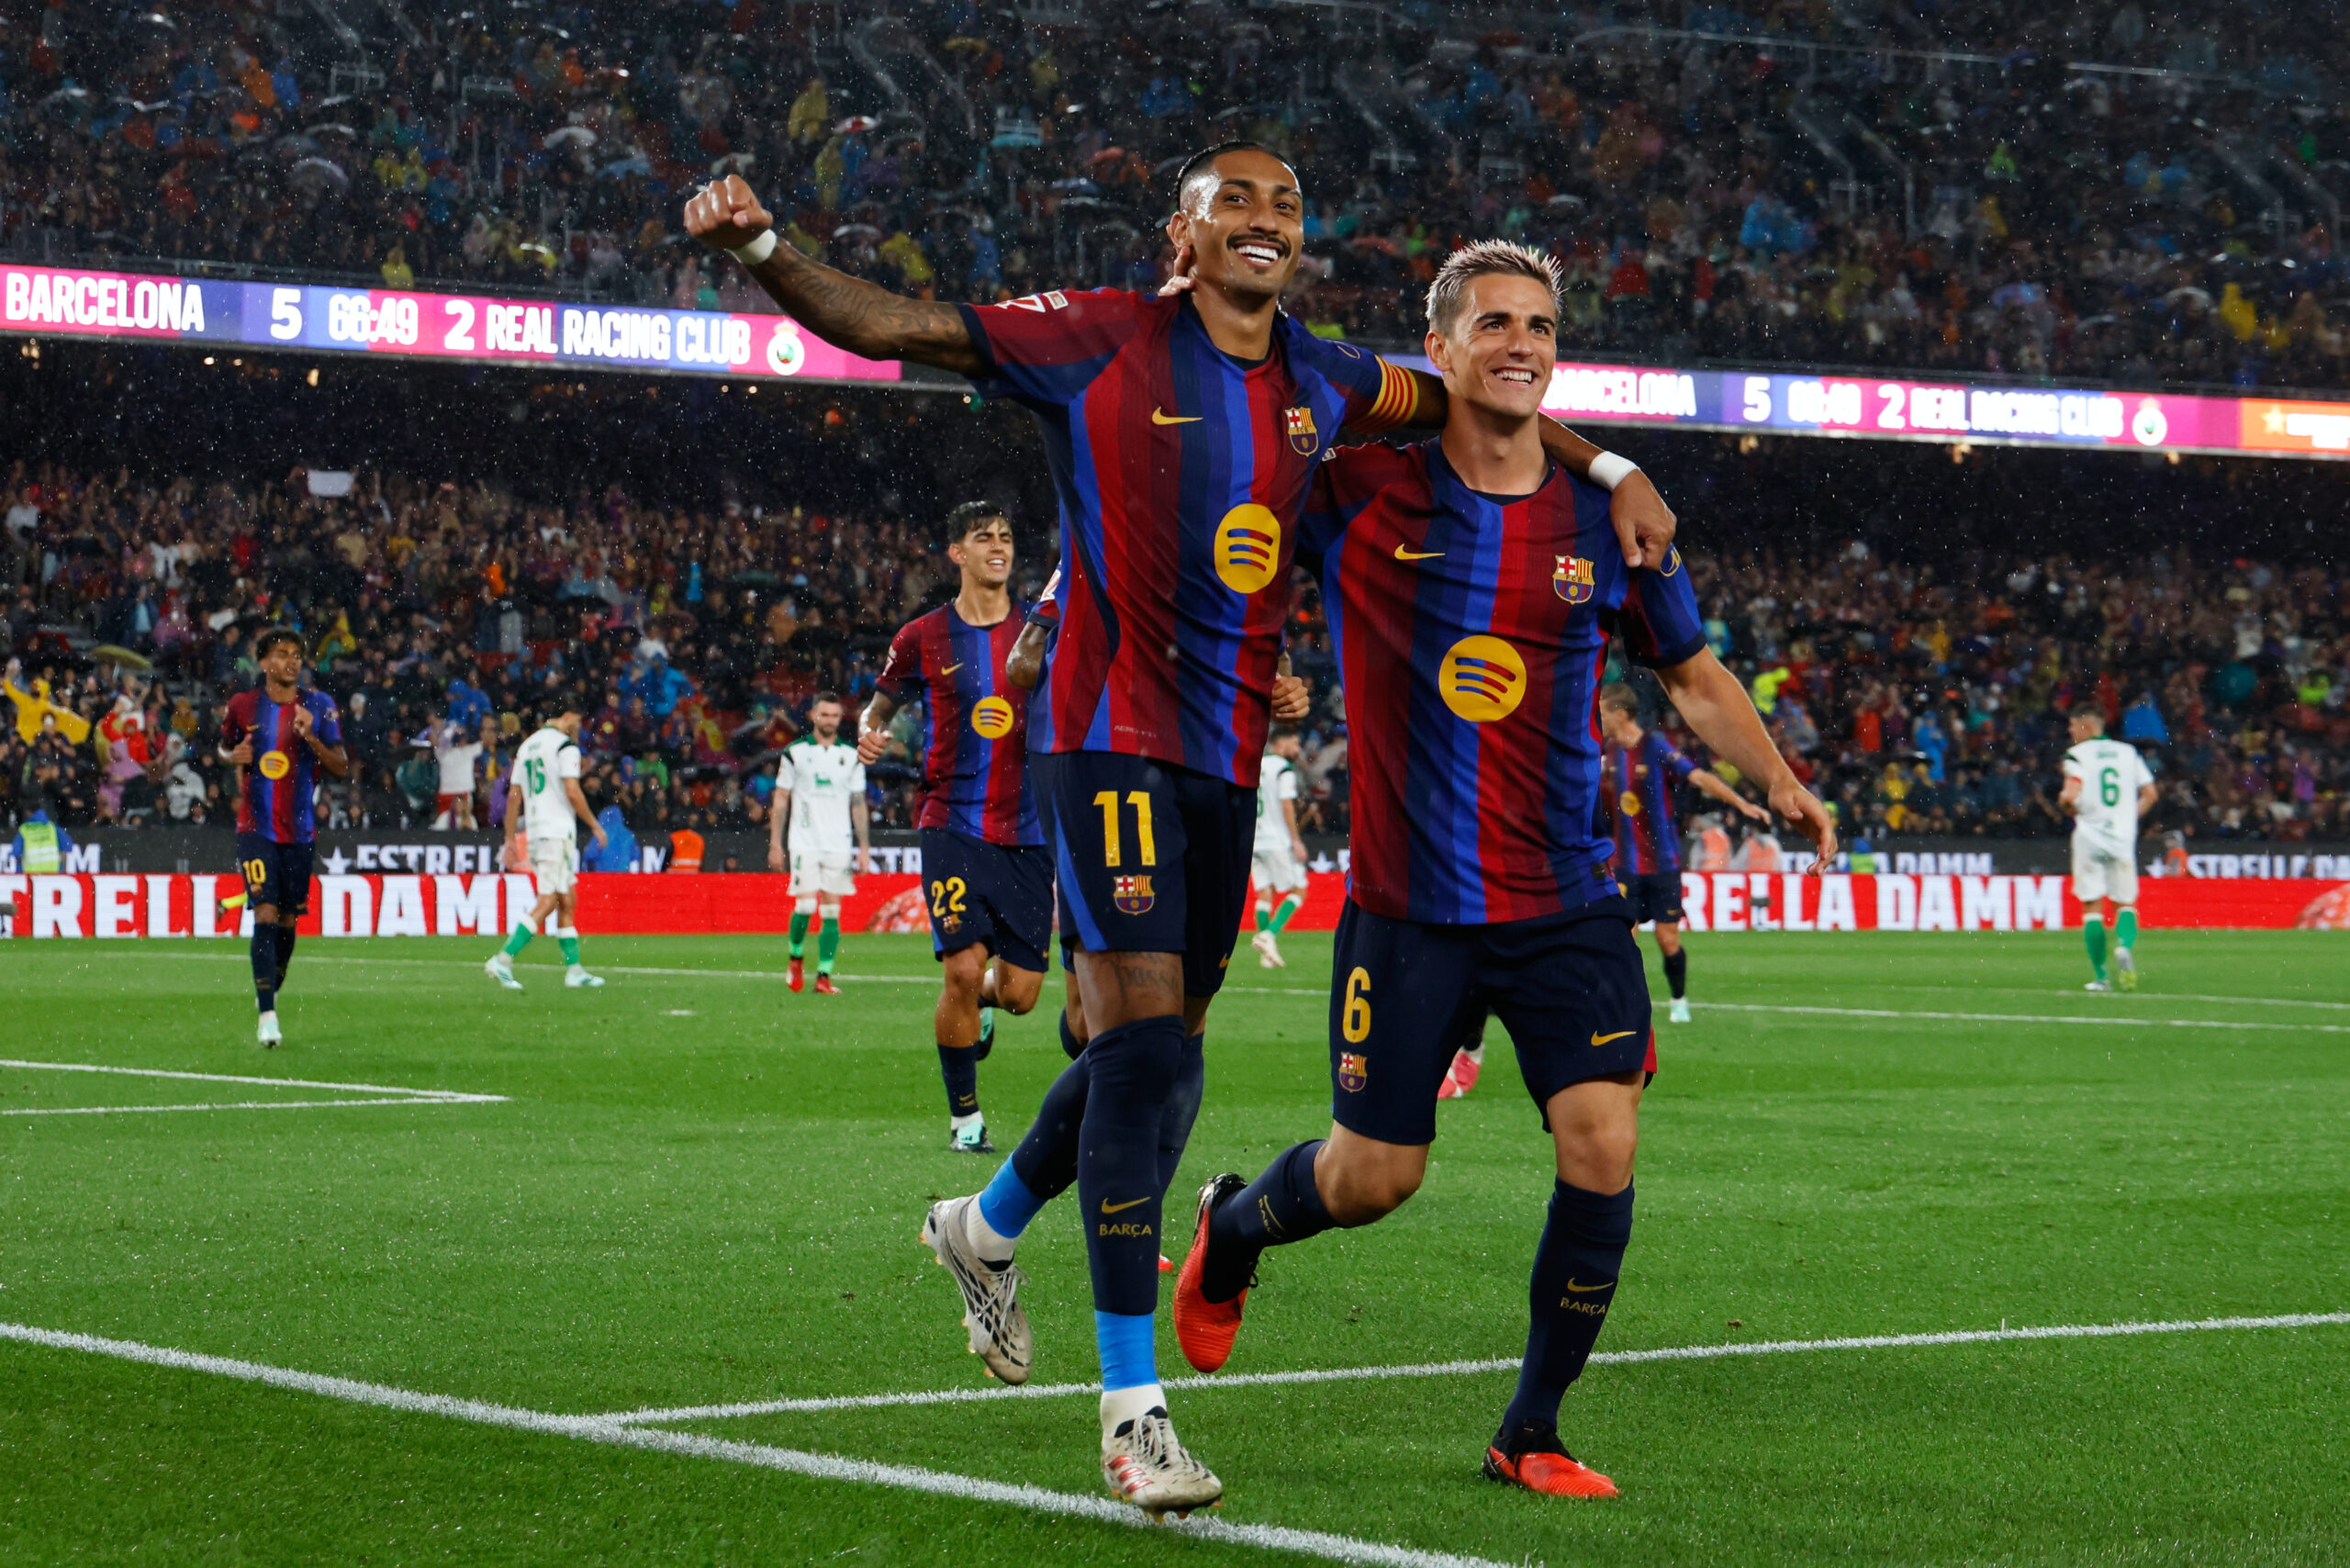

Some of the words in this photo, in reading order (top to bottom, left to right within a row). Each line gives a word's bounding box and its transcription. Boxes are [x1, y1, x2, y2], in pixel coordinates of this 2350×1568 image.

[6, 273, 206, 332] BARCELONA
[270, 287, 302, 340] 5
[329, 294, 419, 345] 66:49
[443, 299, 476, 351] 2
[486, 304, 558, 354] REAL
[563, 308, 672, 361] RACING
[676, 316, 751, 365] CLUB
[1742, 375, 1772, 423] 5
[1877, 383, 1907, 430] 2
[2100, 767, 2121, 807] 6
[1093, 790, 1157, 867] 11
[242, 857, 266, 884] 10
[1897, 852, 1992, 875] DAMM
[931, 876, 967, 917] 22
[1876, 875, 2064, 931] DAMM
[1342, 967, 1371, 1044] 6
[1099, 1223, 1152, 1238] BARÇA
[1560, 1296, 1606, 1316] BARÇA
